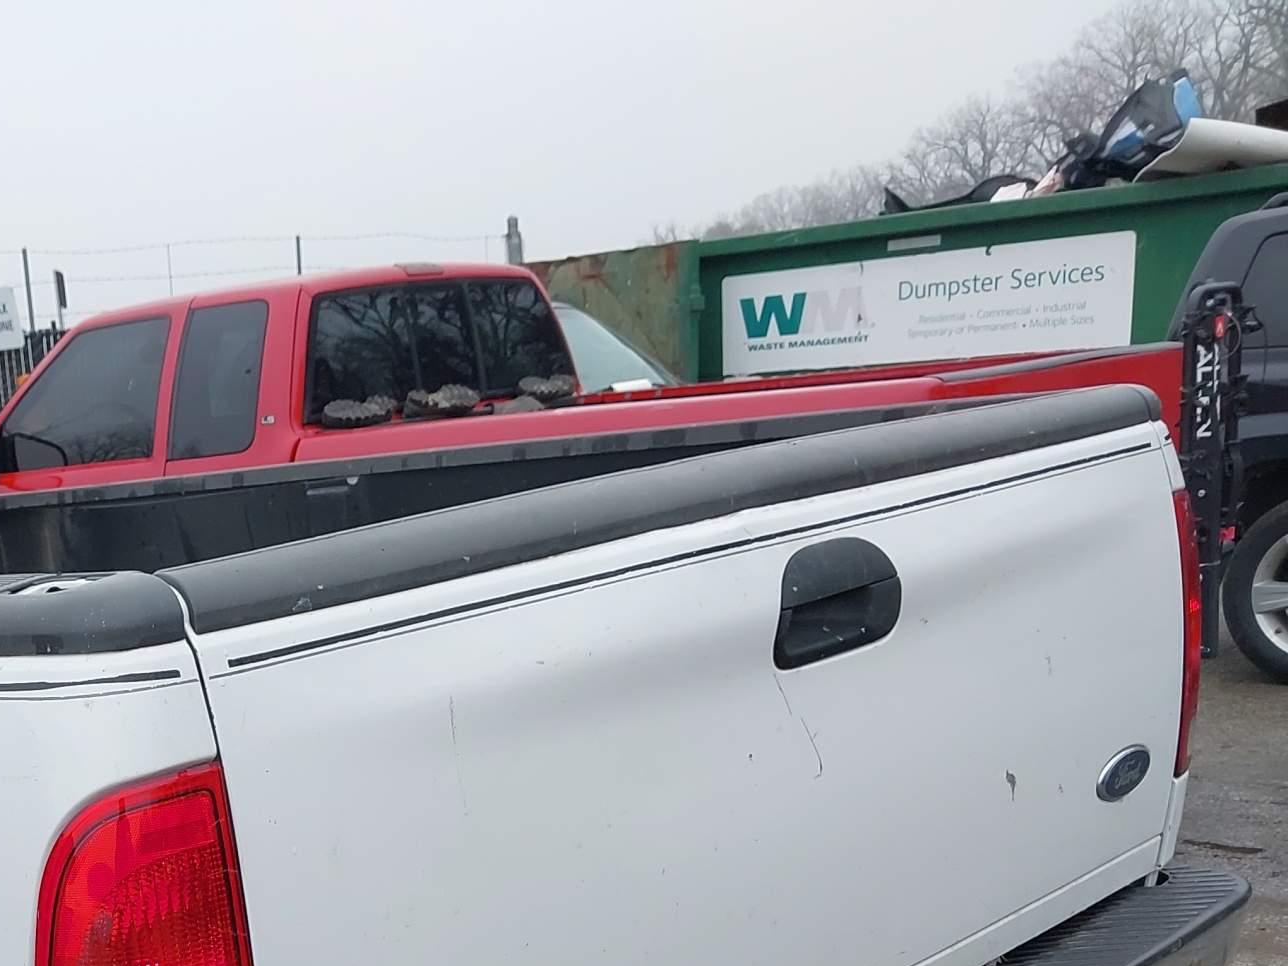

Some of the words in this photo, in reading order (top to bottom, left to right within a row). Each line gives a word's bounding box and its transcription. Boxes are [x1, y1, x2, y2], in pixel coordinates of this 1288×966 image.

[897, 274, 1003, 302] Dumpster
[1009, 263, 1106, 290] Services
[976, 304, 1032, 321] Commercial
[1042, 300, 1087, 314] Industrial
[1028, 314, 1068, 329] Multiple
[748, 341, 785, 352] WASTE
[788, 334, 869, 350] MANAGEMENT
